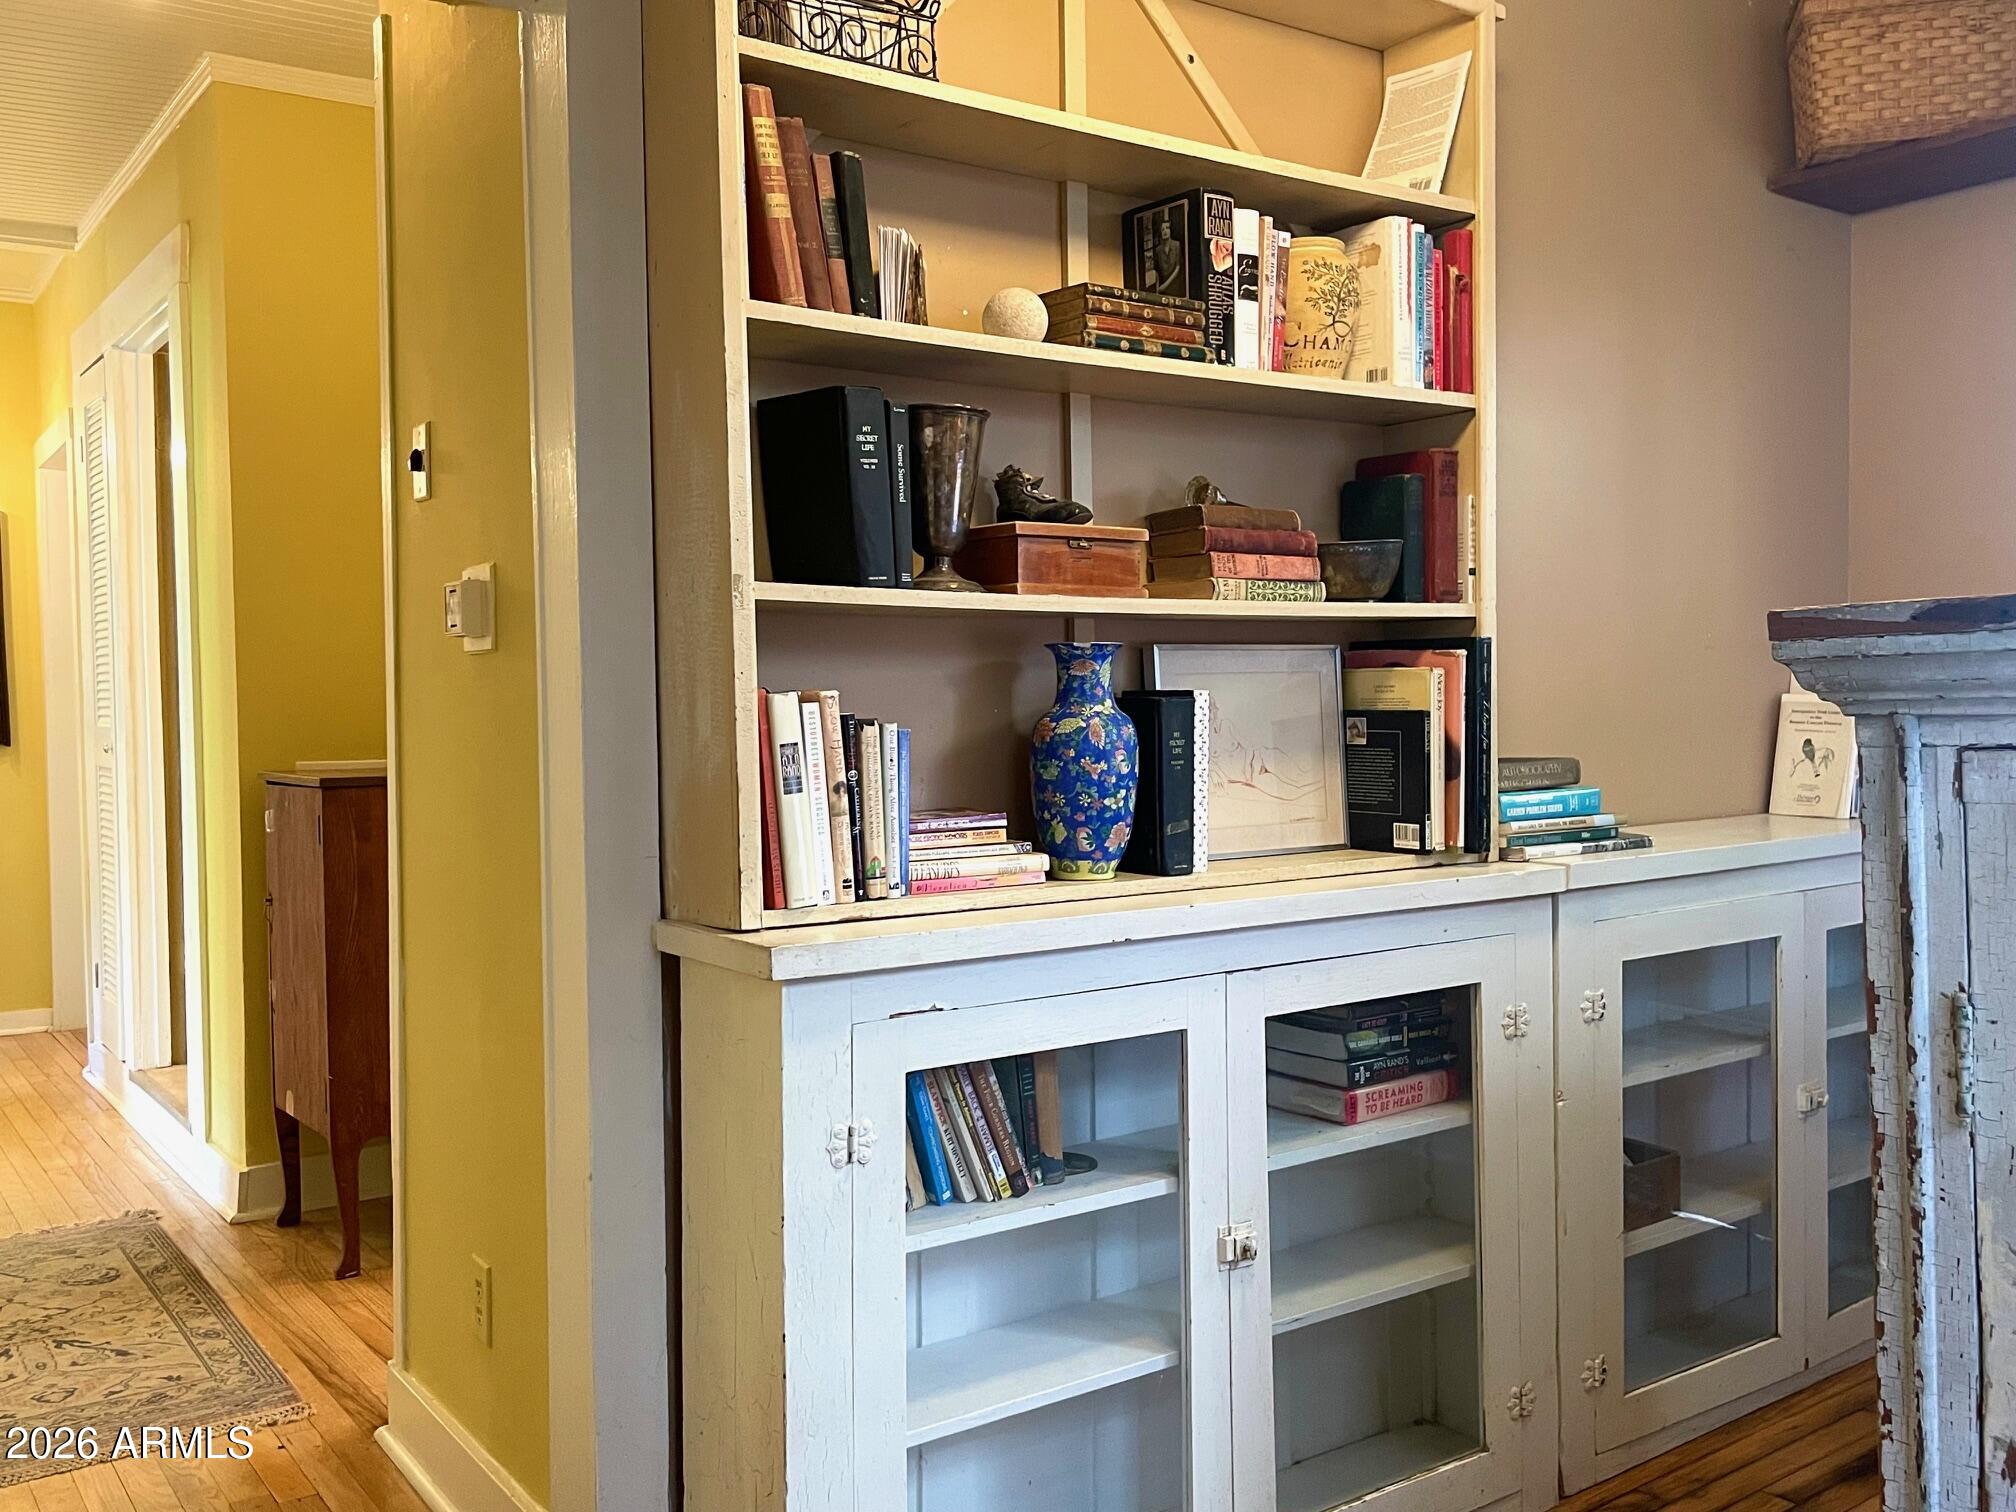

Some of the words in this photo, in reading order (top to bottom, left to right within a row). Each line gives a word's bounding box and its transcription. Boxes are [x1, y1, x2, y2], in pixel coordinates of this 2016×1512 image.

[1211, 199, 1230, 219] AYN
[1208, 218, 1232, 238] RAND
[1222, 275, 1233, 315] ATLAS
[1208, 274, 1223, 345] SHRUGGED
[855, 434, 879, 442] SECRET
[861, 443, 875, 451] LIFE
[897, 443, 905, 467] Some
[898, 468, 907, 503] Survived
[826, 696, 840, 733] SLOW
[830, 739, 842, 774] HAND
[1373, 1062, 1386, 1070] AYN
[1387, 1055, 1409, 1068] RAND'S
[968, 1092, 980, 1113] BACK
[1365, 1081, 1424, 1103] SCREAMING
[1365, 1102, 1378, 1115] TO
[1380, 1100, 1390, 1112] BE
[1393, 1094, 1424, 1110] HEARD
[927, 1080, 947, 1126] SLAPSTICK
[944, 1127, 956, 1146] KURT
[950, 1146, 967, 1179] VONNEGUT
[991, 1108, 1006, 1139] CORNERS
[1002, 1140, 1015, 1167] REGION
